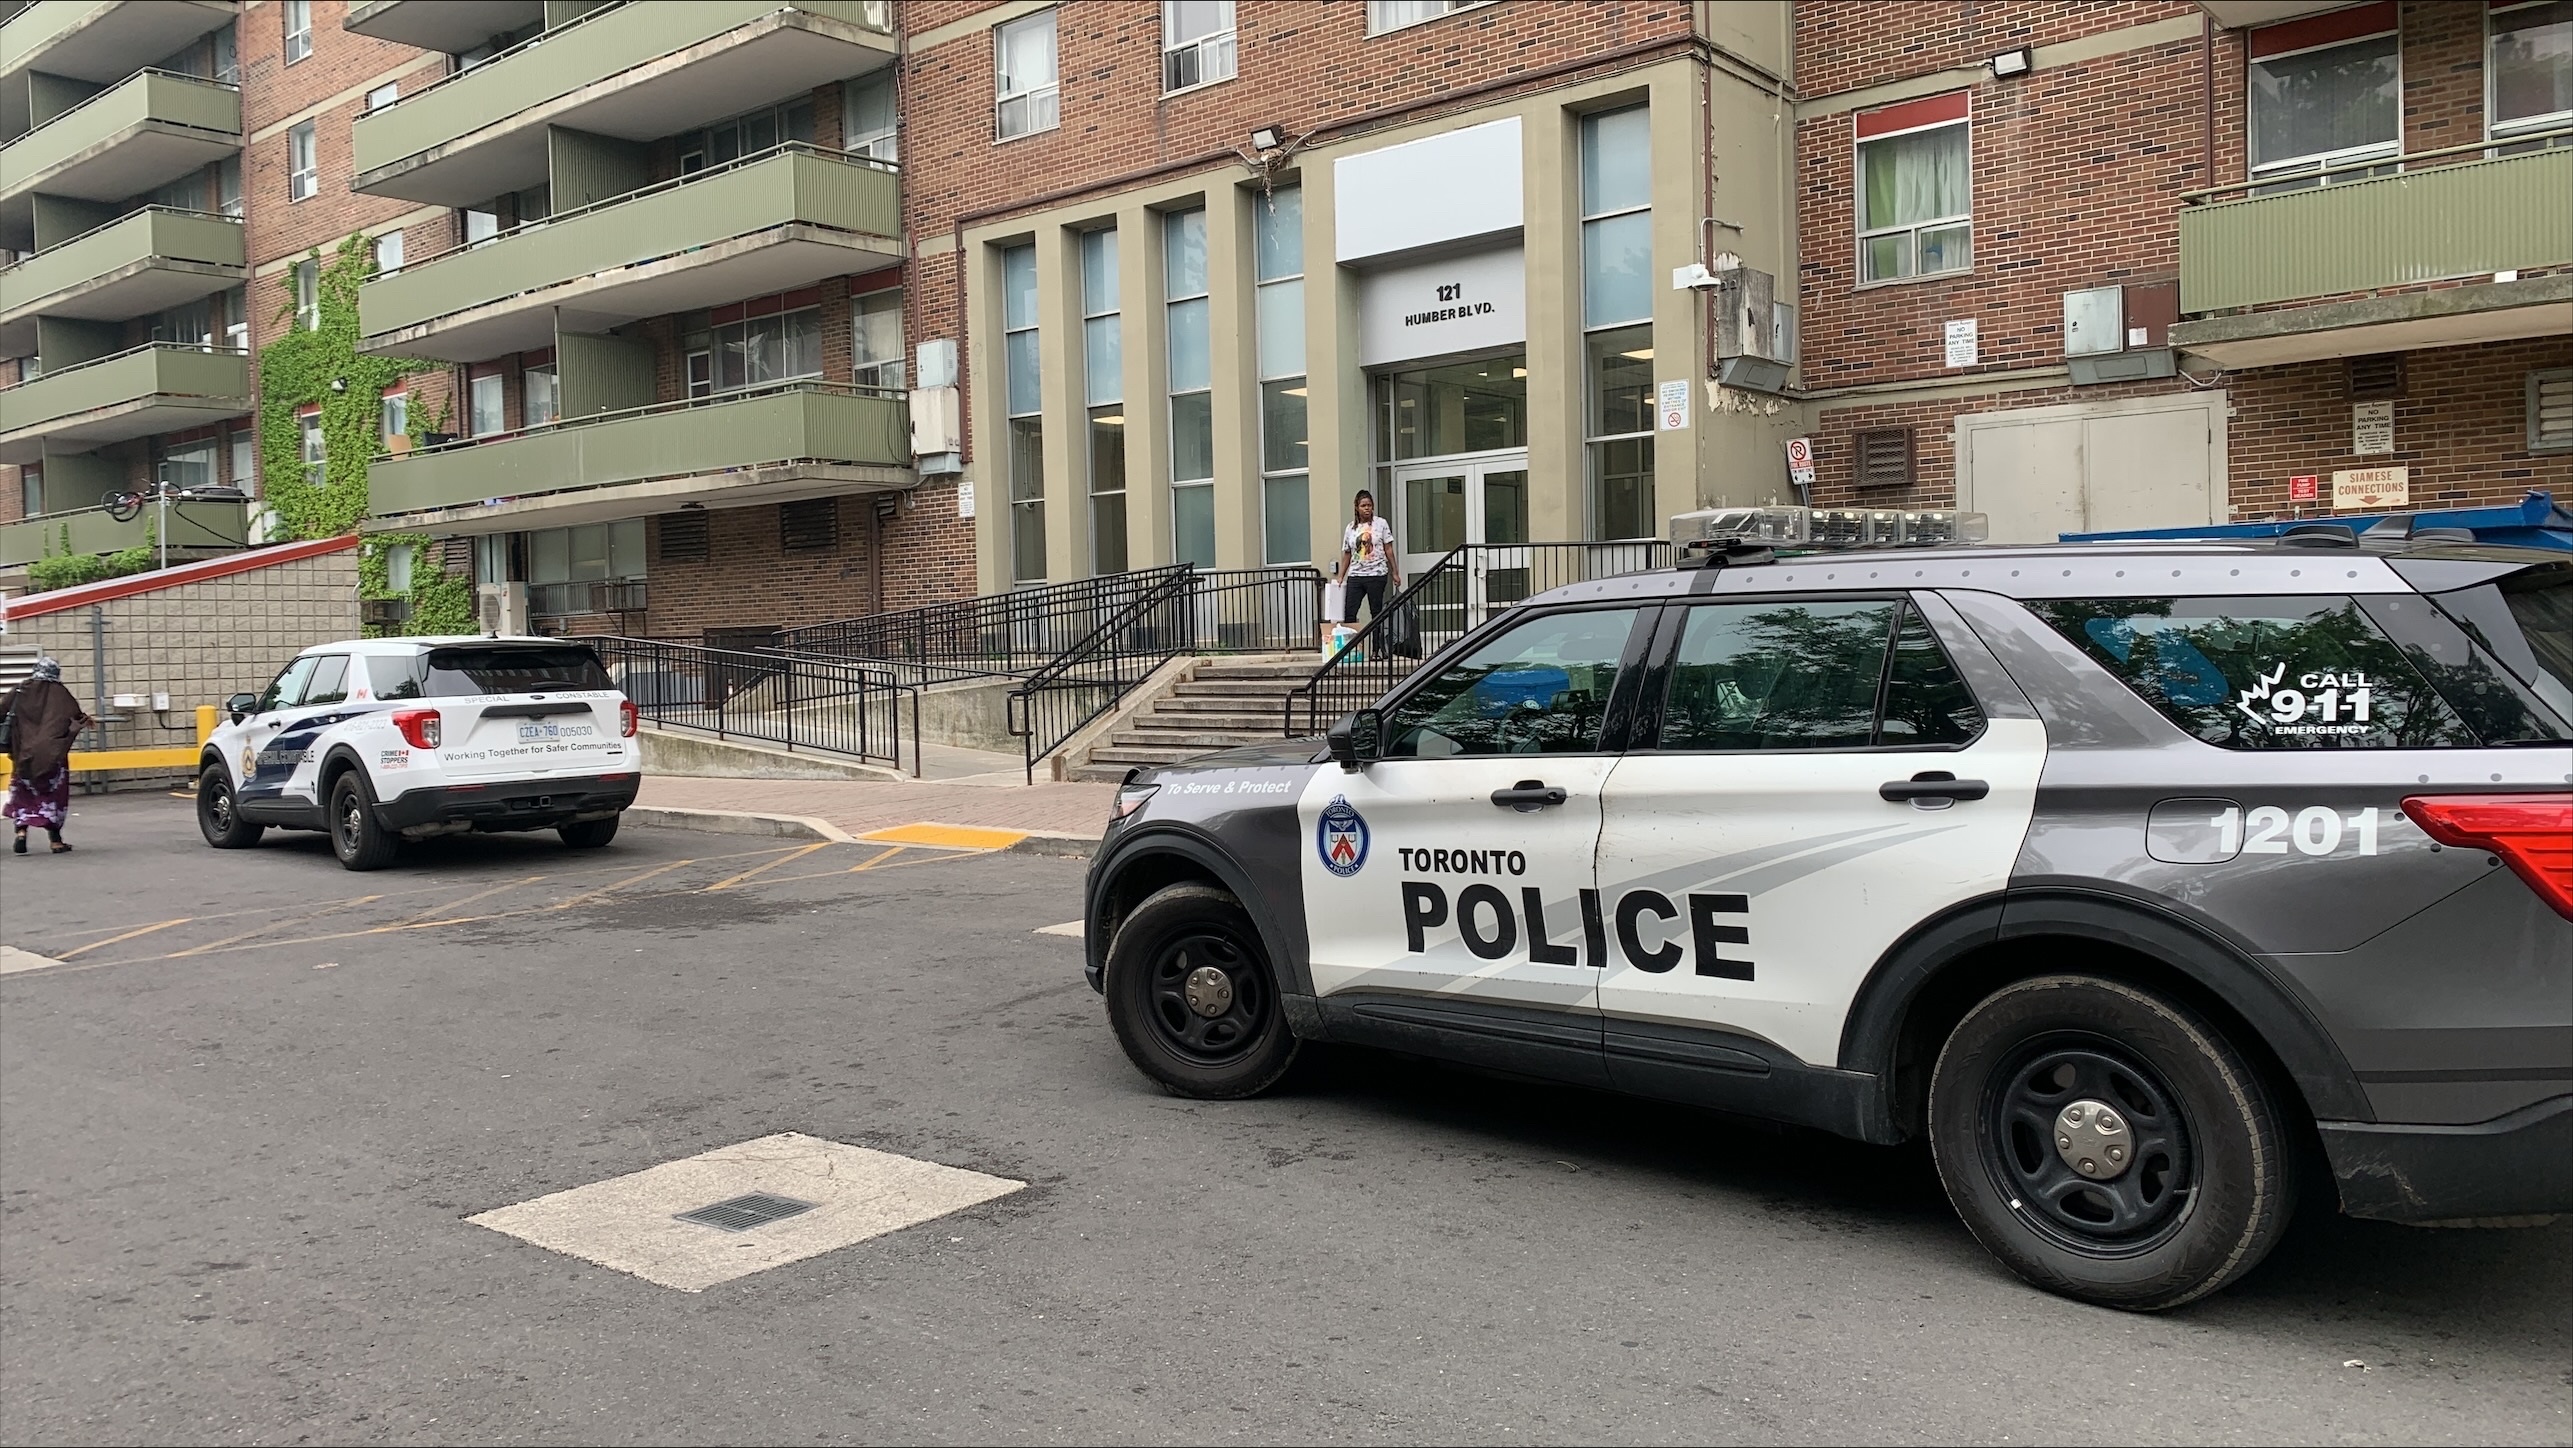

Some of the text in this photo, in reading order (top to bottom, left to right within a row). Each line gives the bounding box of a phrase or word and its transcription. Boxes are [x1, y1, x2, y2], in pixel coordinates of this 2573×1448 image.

[1436, 282, 1461, 302] 121
[1405, 302, 1495, 327] HUMBER BLVD.
[1949, 332, 1974, 340] PARKING
[2357, 415, 2389, 423] PARKING
[2349, 470, 2392, 483] SIAMESE
[2338, 481, 2404, 495] CONNECTIONS
[2300, 673, 2373, 688] CALL
[464, 691, 610, 704] SPECIAL CONSTABLE
[2271, 688, 2371, 723] 9-1-1
[560, 725, 593, 737] 005030
[2275, 725, 2370, 735] EMERGENCY
[444, 750, 486, 761] Working
[488, 748, 528, 758] Together
[546, 743, 568, 753] Safer
[570, 742, 622, 751] Communities
[380, 756, 408, 764] STOPPERS
[1167, 780, 1292, 795] To Serve & Protect
[1325, 806, 1355, 817] TORONTO
[2210, 805, 2379, 856] 1201
[1398, 848, 1526, 876] TORONTO
[1333, 866, 1355, 875] POLICE
[1401, 881, 1755, 982] POLICE
